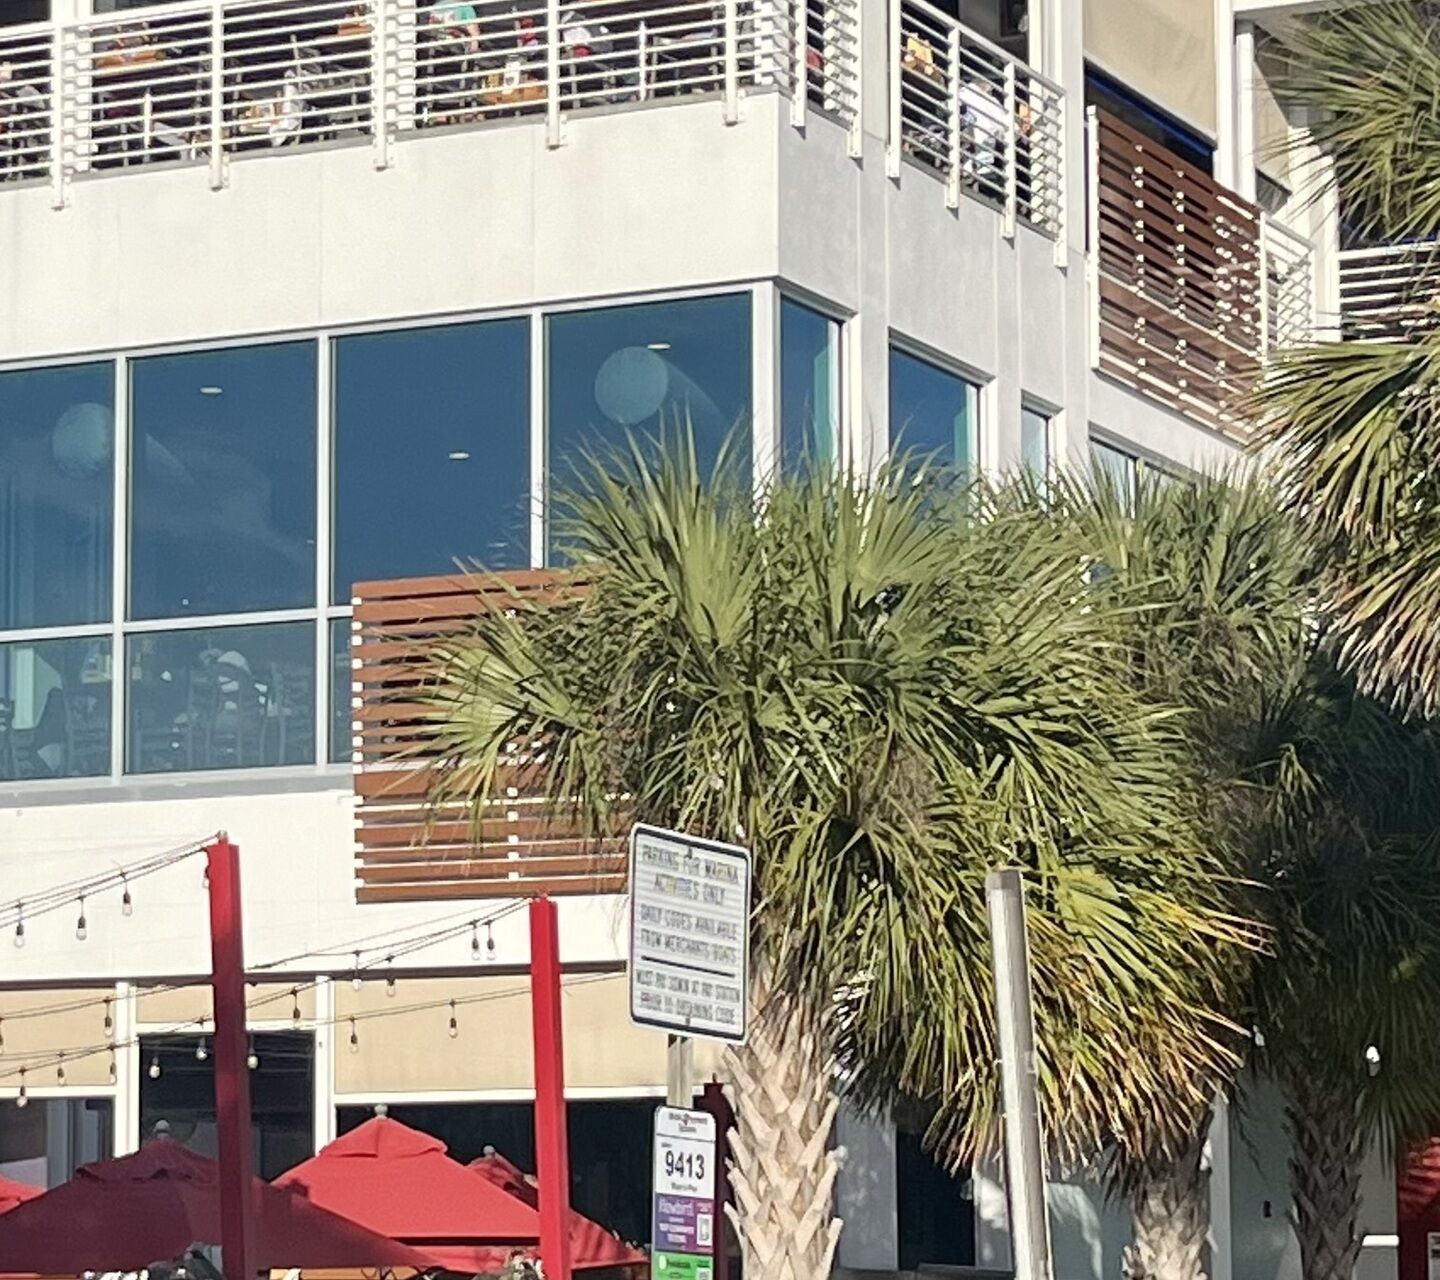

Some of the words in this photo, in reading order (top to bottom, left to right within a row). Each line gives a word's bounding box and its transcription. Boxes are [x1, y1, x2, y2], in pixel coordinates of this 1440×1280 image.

[643, 844, 679, 871] PARKING
[703, 882, 725, 905] ONLY
[641, 928, 662, 948] FROM
[695, 917, 739, 941] AVAILABLE
[665, 1150, 705, 1180] 9413
